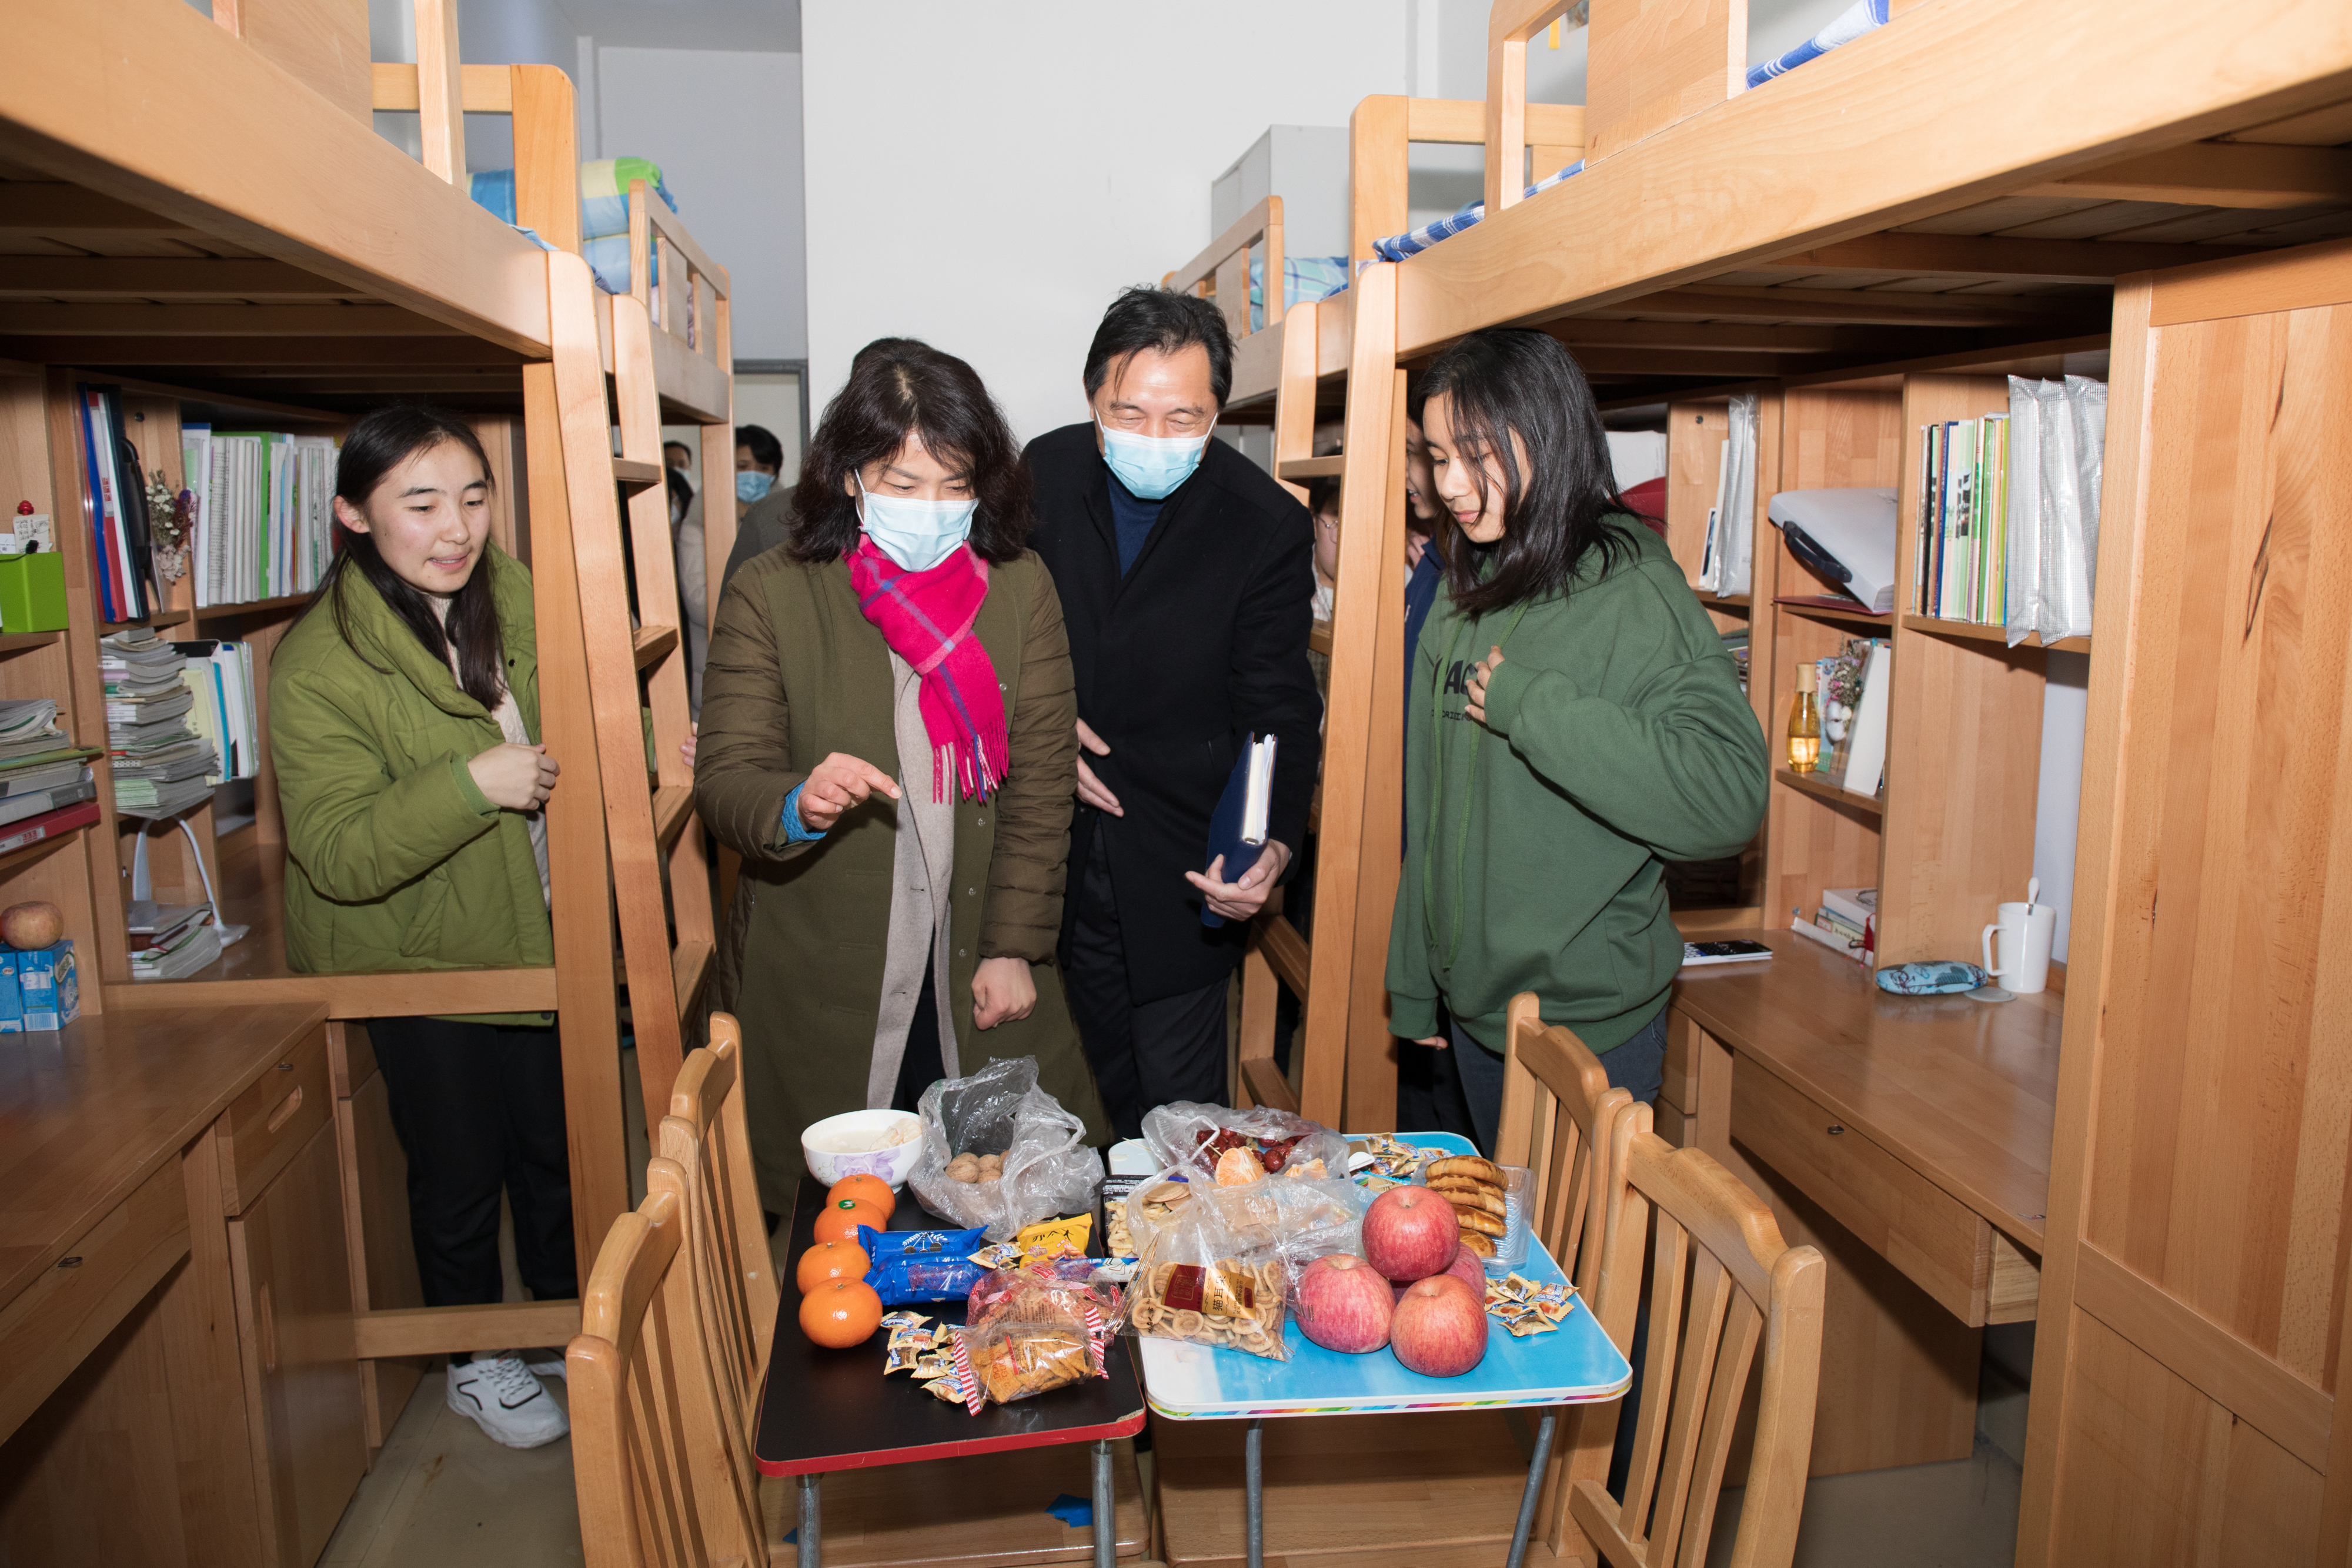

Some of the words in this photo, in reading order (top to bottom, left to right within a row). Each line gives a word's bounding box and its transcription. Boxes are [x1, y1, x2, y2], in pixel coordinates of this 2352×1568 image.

[1212, 1275, 1226, 1311] 猫耳朵
[995, 1348, 1008, 1378] GUOBA
